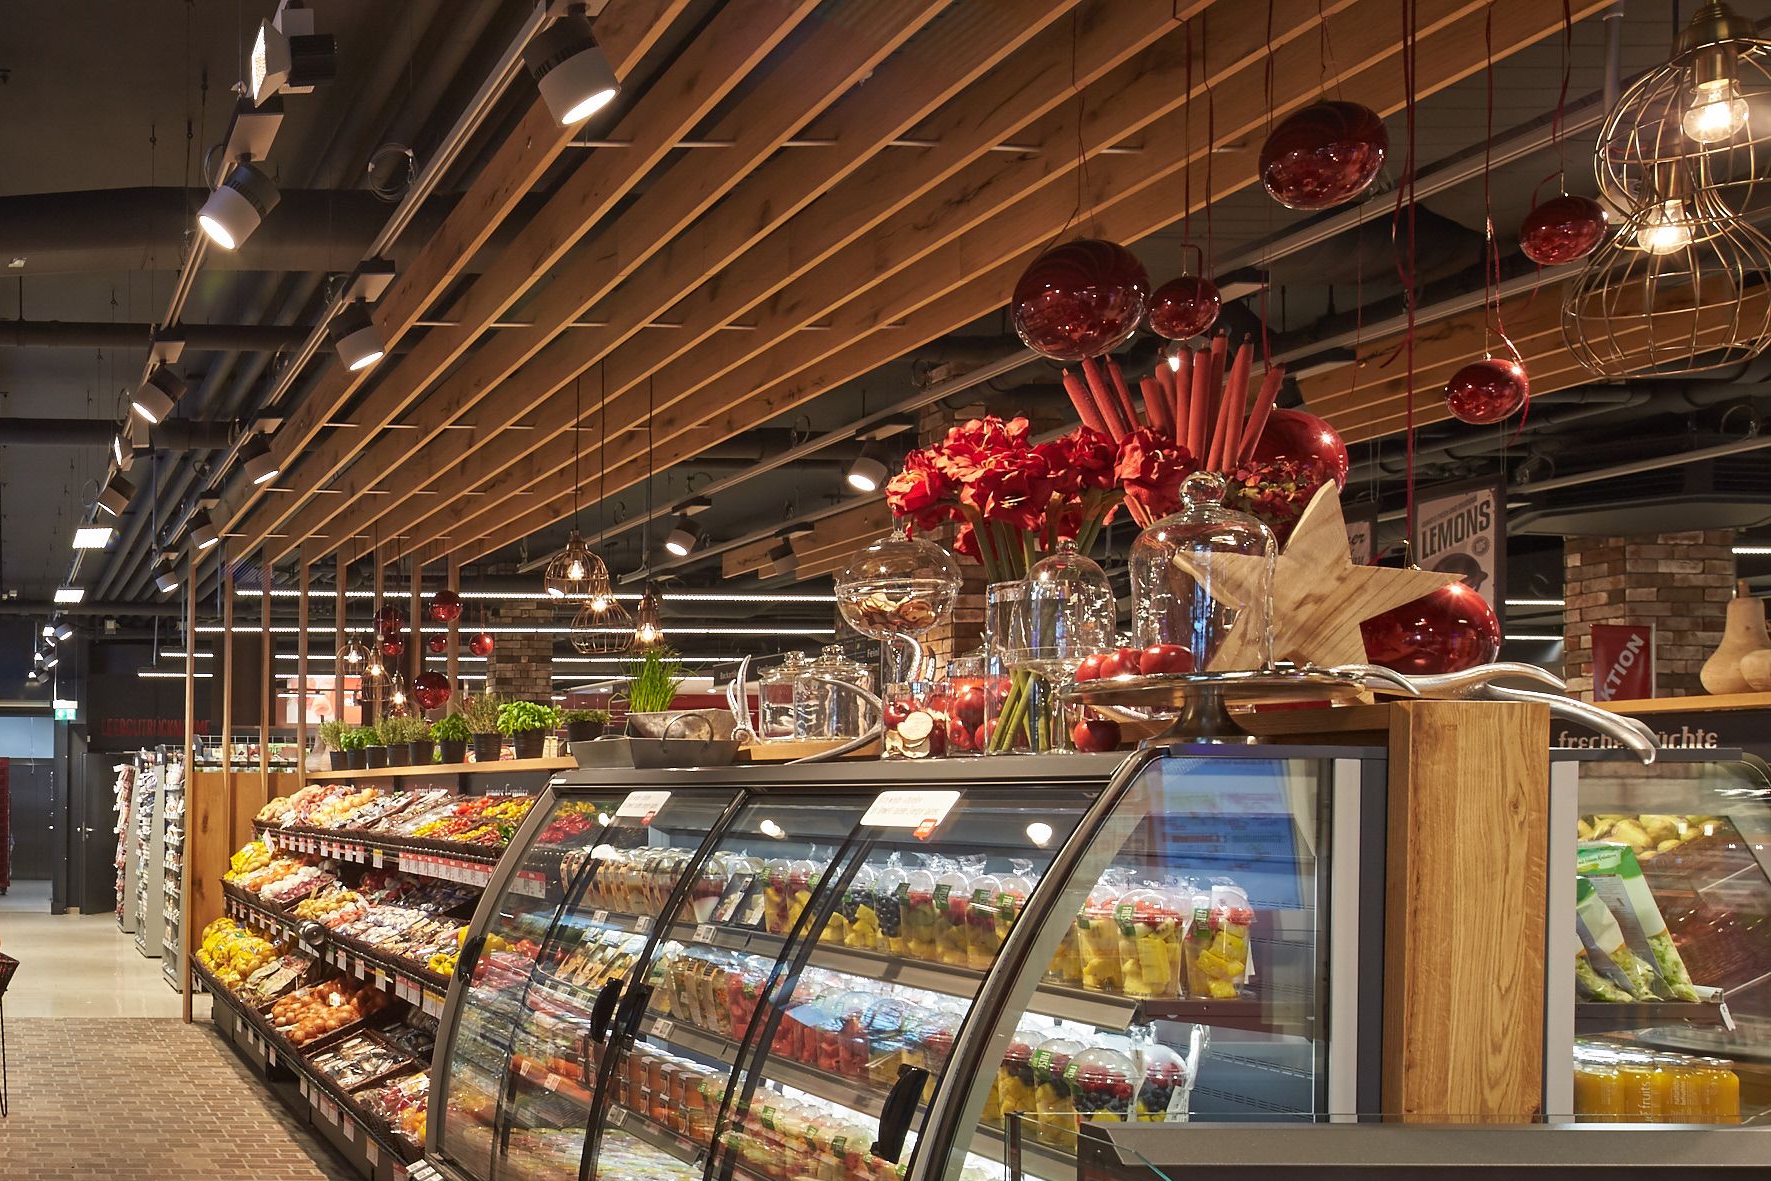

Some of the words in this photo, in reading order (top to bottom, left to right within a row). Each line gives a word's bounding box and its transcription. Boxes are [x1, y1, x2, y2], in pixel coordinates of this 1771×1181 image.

[1422, 500, 1491, 560] LEMONS
[1600, 634, 1645, 700] KTION
[1638, 1081, 1651, 1109] fruits
